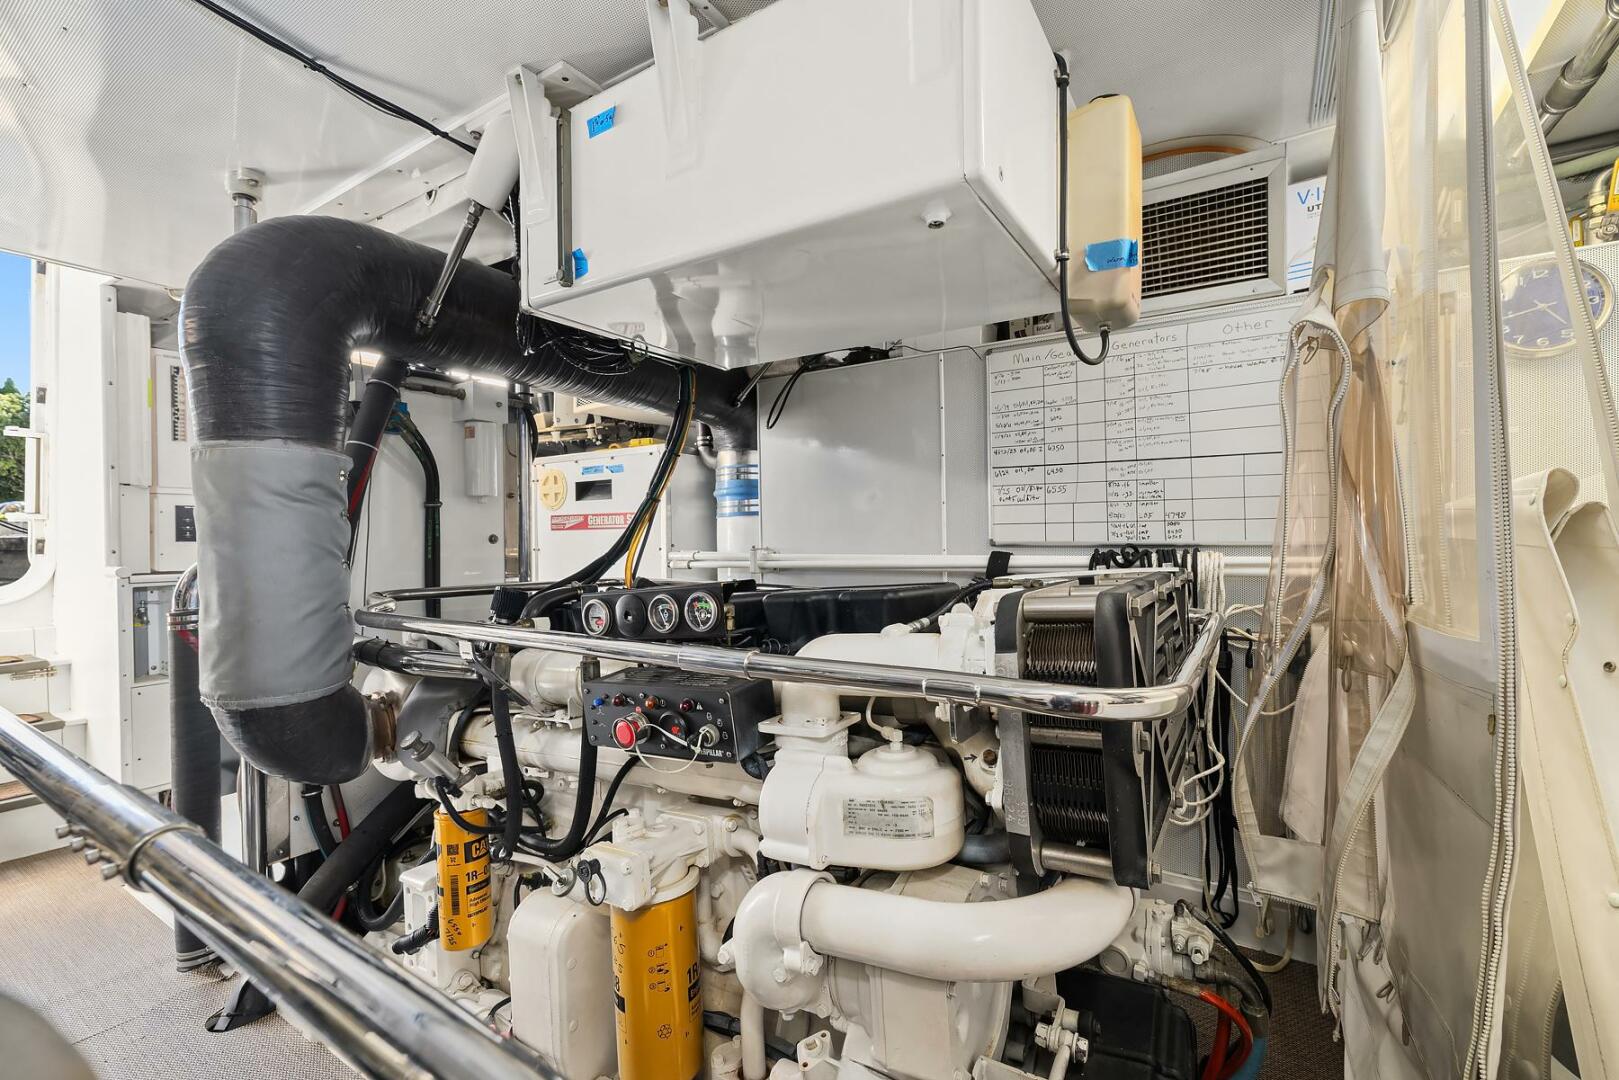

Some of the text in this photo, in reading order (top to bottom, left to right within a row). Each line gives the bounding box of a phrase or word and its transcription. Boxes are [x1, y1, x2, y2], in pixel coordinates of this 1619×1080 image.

[1307, 203, 1322, 212] UT
[1222, 320, 1273, 335] Other
[1111, 331, 1178, 351] Generators
[588, 514, 625, 525] GENERATOR
[471, 839, 488, 858] CA
